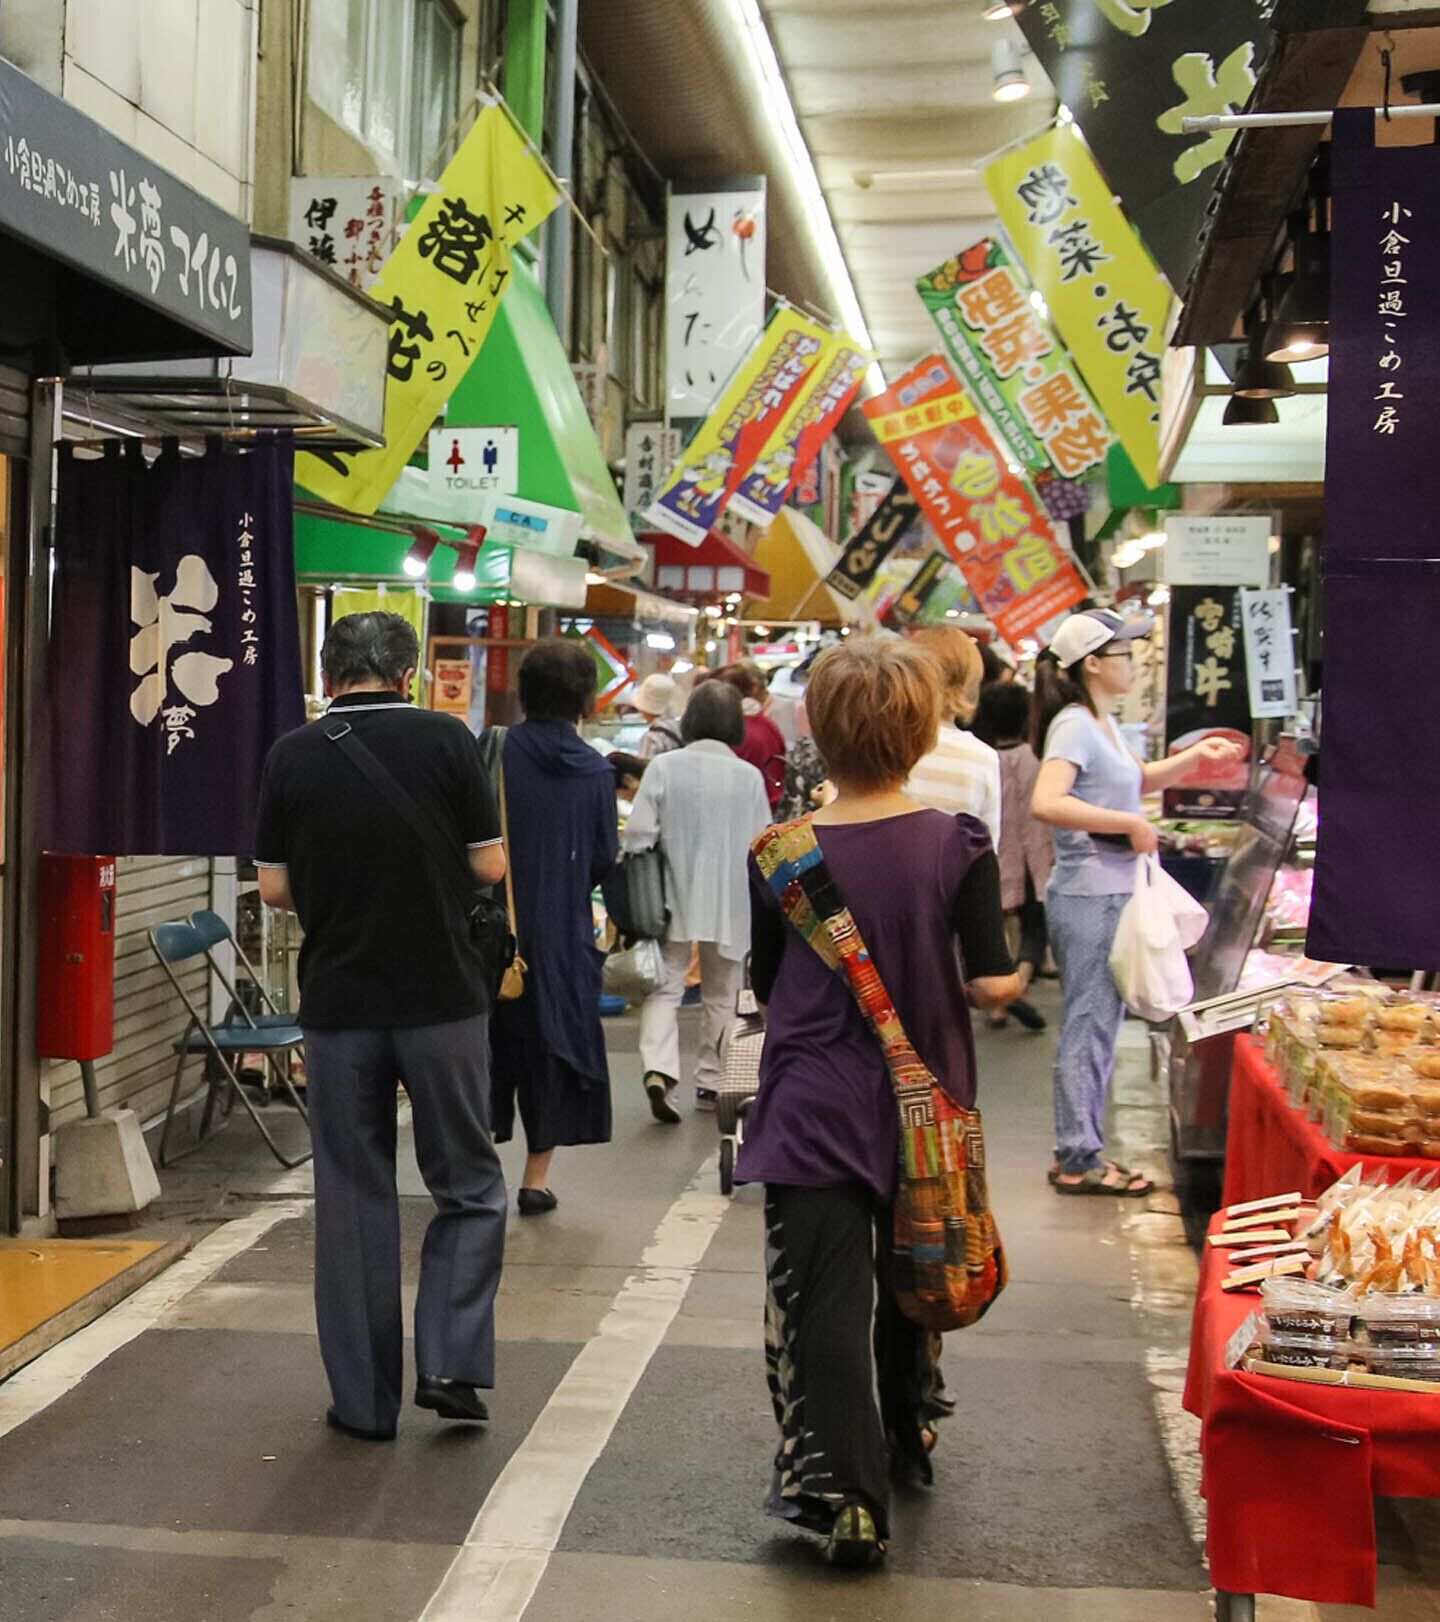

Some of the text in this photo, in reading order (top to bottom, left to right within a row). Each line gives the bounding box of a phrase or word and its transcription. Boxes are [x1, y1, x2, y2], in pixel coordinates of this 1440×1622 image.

[1373, 202, 1413, 435] 小倉旦過こめ工房
[445, 477, 500, 490] TOILET
[237, 512, 261, 666] 小倉旦過こめ工房
